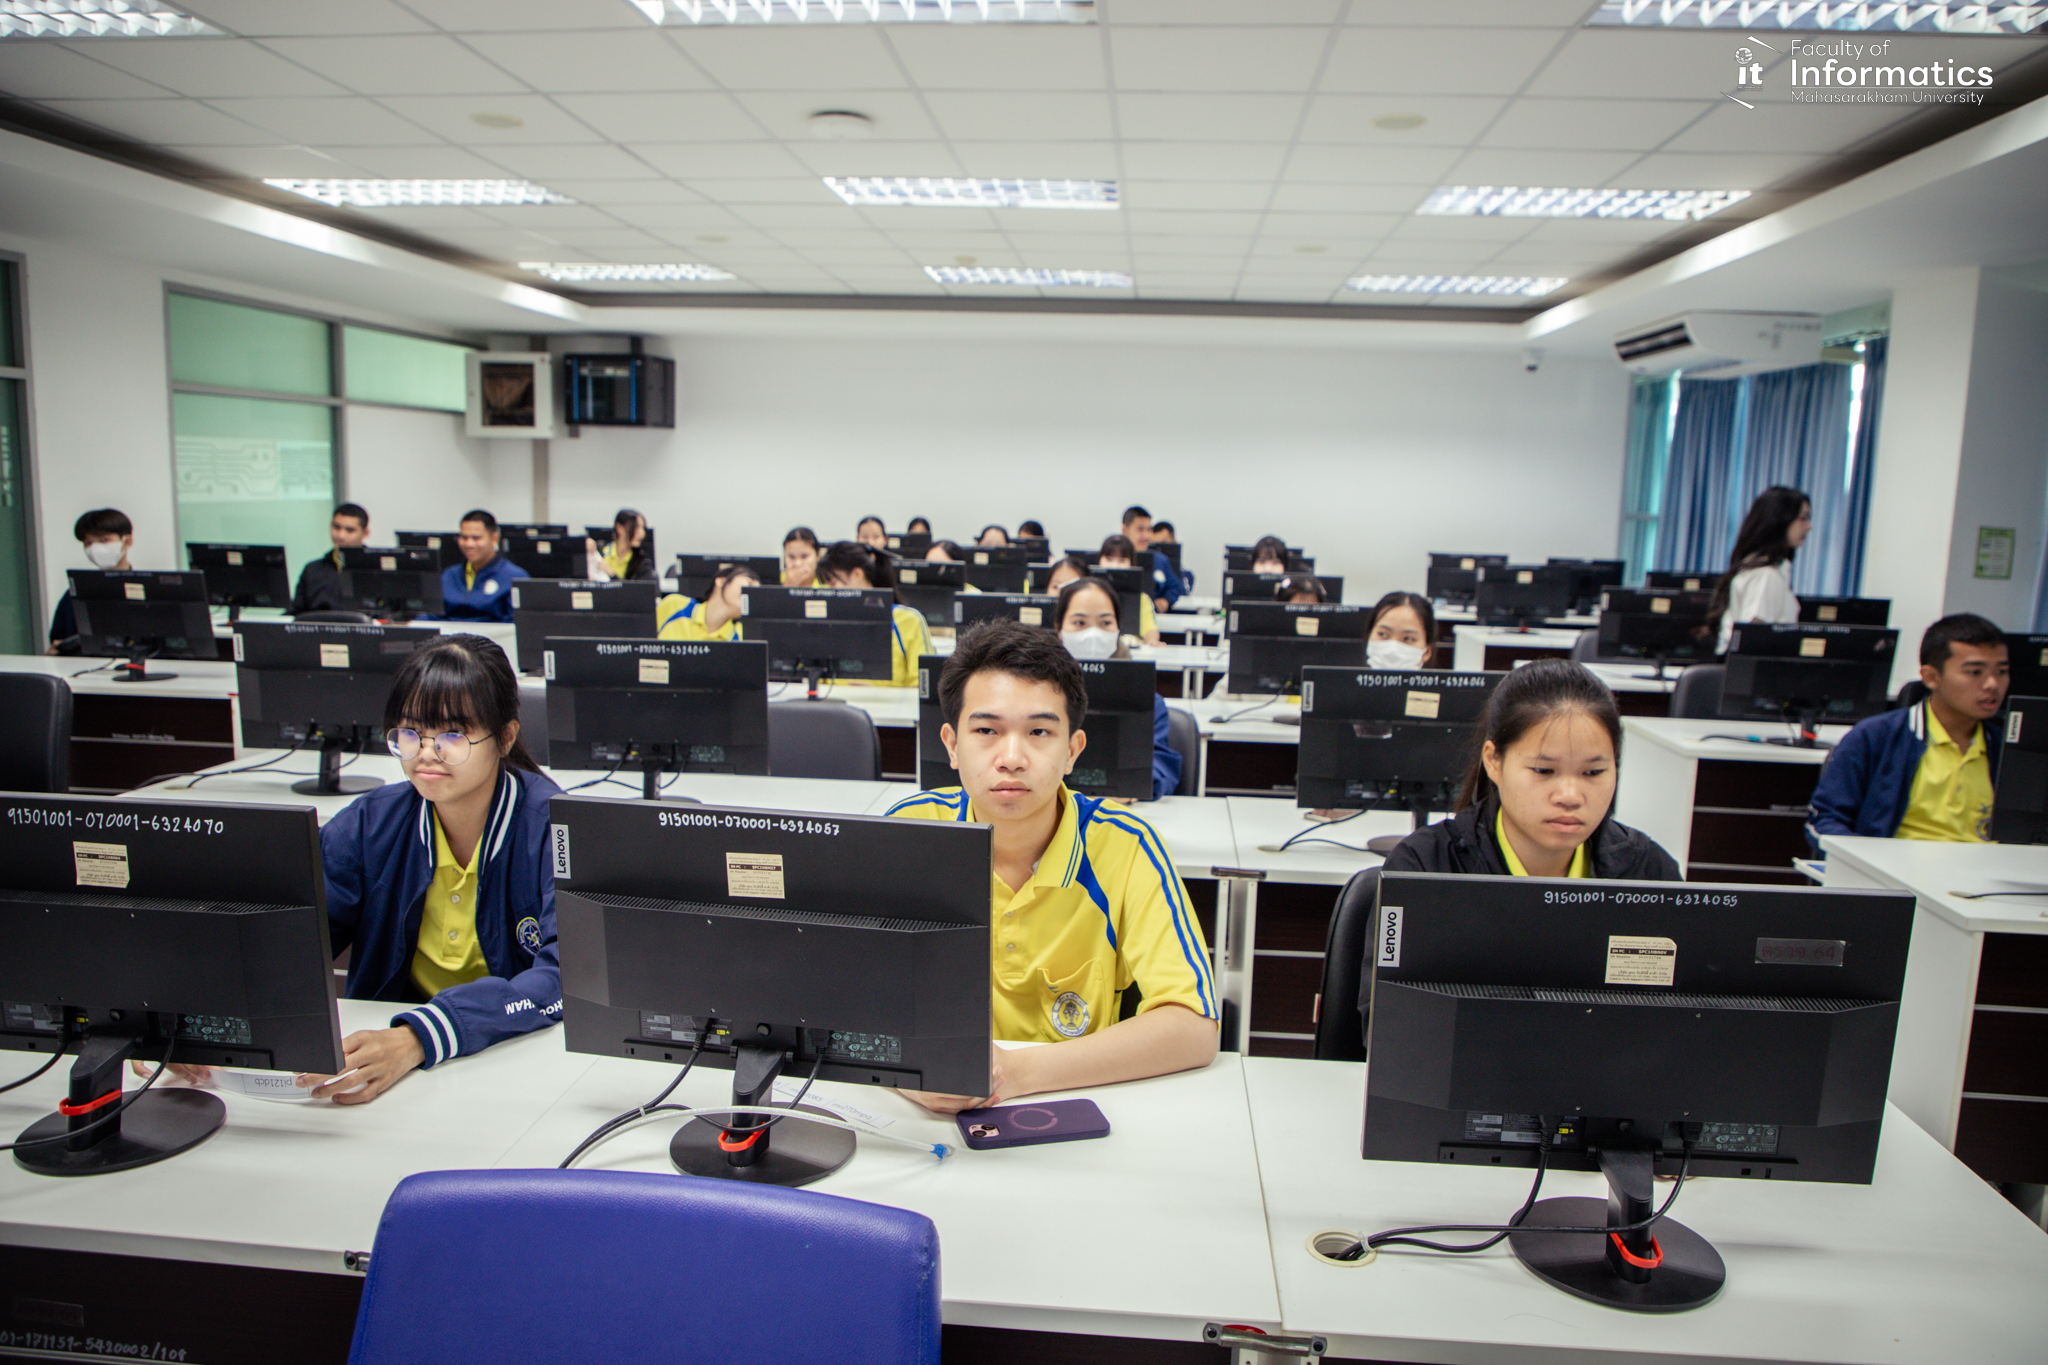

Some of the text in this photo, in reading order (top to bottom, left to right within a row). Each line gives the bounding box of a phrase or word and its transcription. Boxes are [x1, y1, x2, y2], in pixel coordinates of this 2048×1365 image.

[7, 807, 224, 835] 91501001-070001-6324070
[659, 811, 840, 836] 91501001-070001-6324057
[556, 829, 567, 874] Lenovo
[1544, 890, 1738, 907] 91501001-070001-6324055
[1382, 911, 1397, 962] Lenovo
[1814, 945, 1836, 960] 64
[254, 1077, 292, 1089] pi121dcb
